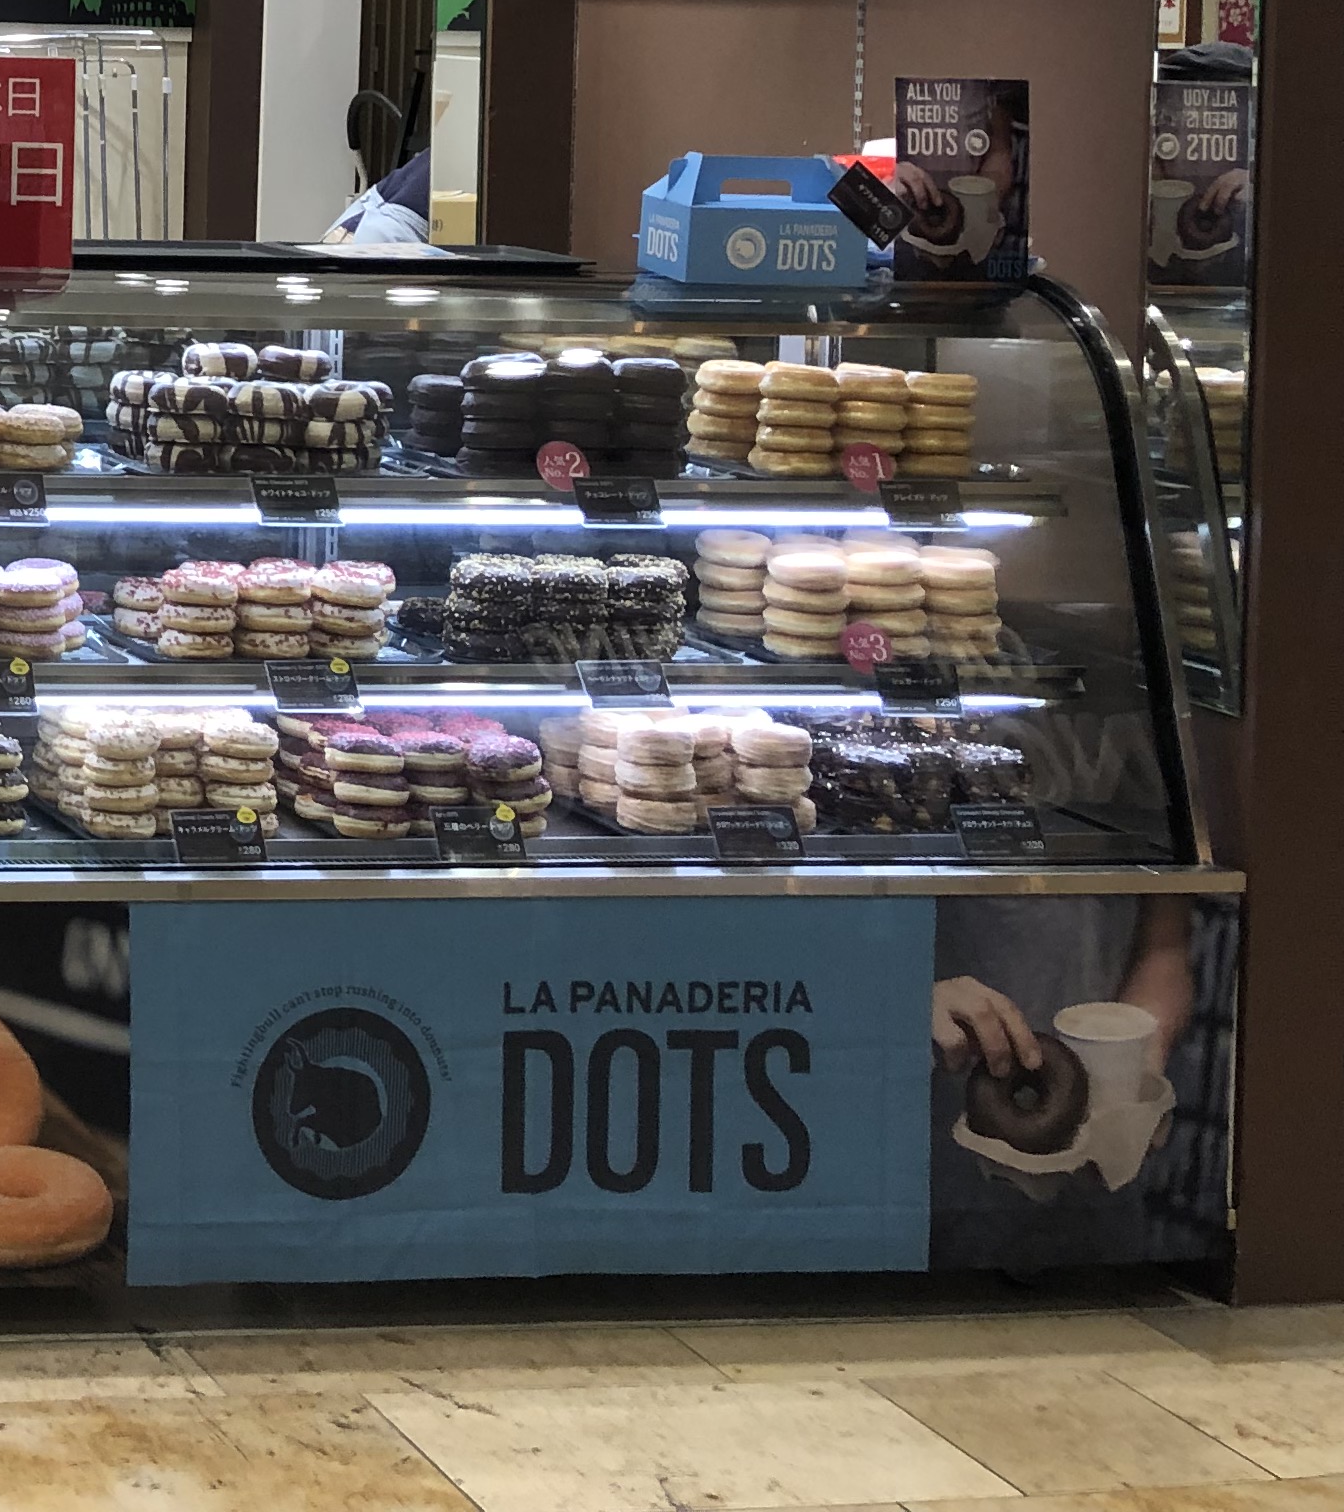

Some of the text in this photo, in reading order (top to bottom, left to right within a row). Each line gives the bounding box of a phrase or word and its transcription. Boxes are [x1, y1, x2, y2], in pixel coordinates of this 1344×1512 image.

[907, 83, 961, 101] ALL YOU
[907, 105, 959, 124] NEED IS
[907, 128, 958, 156] DOTS
[646, 226, 679, 263] DOTS
[776, 239, 837, 271] DOTS
[988, 258, 1022, 279] DOTS
[314, 986, 344, 999] stop
[346, 986, 397, 1010] rushing
[398, 1003, 421, 1026] into
[502, 980, 813, 1015] LA PANADERIA
[500, 1028, 812, 1195] DOTS
